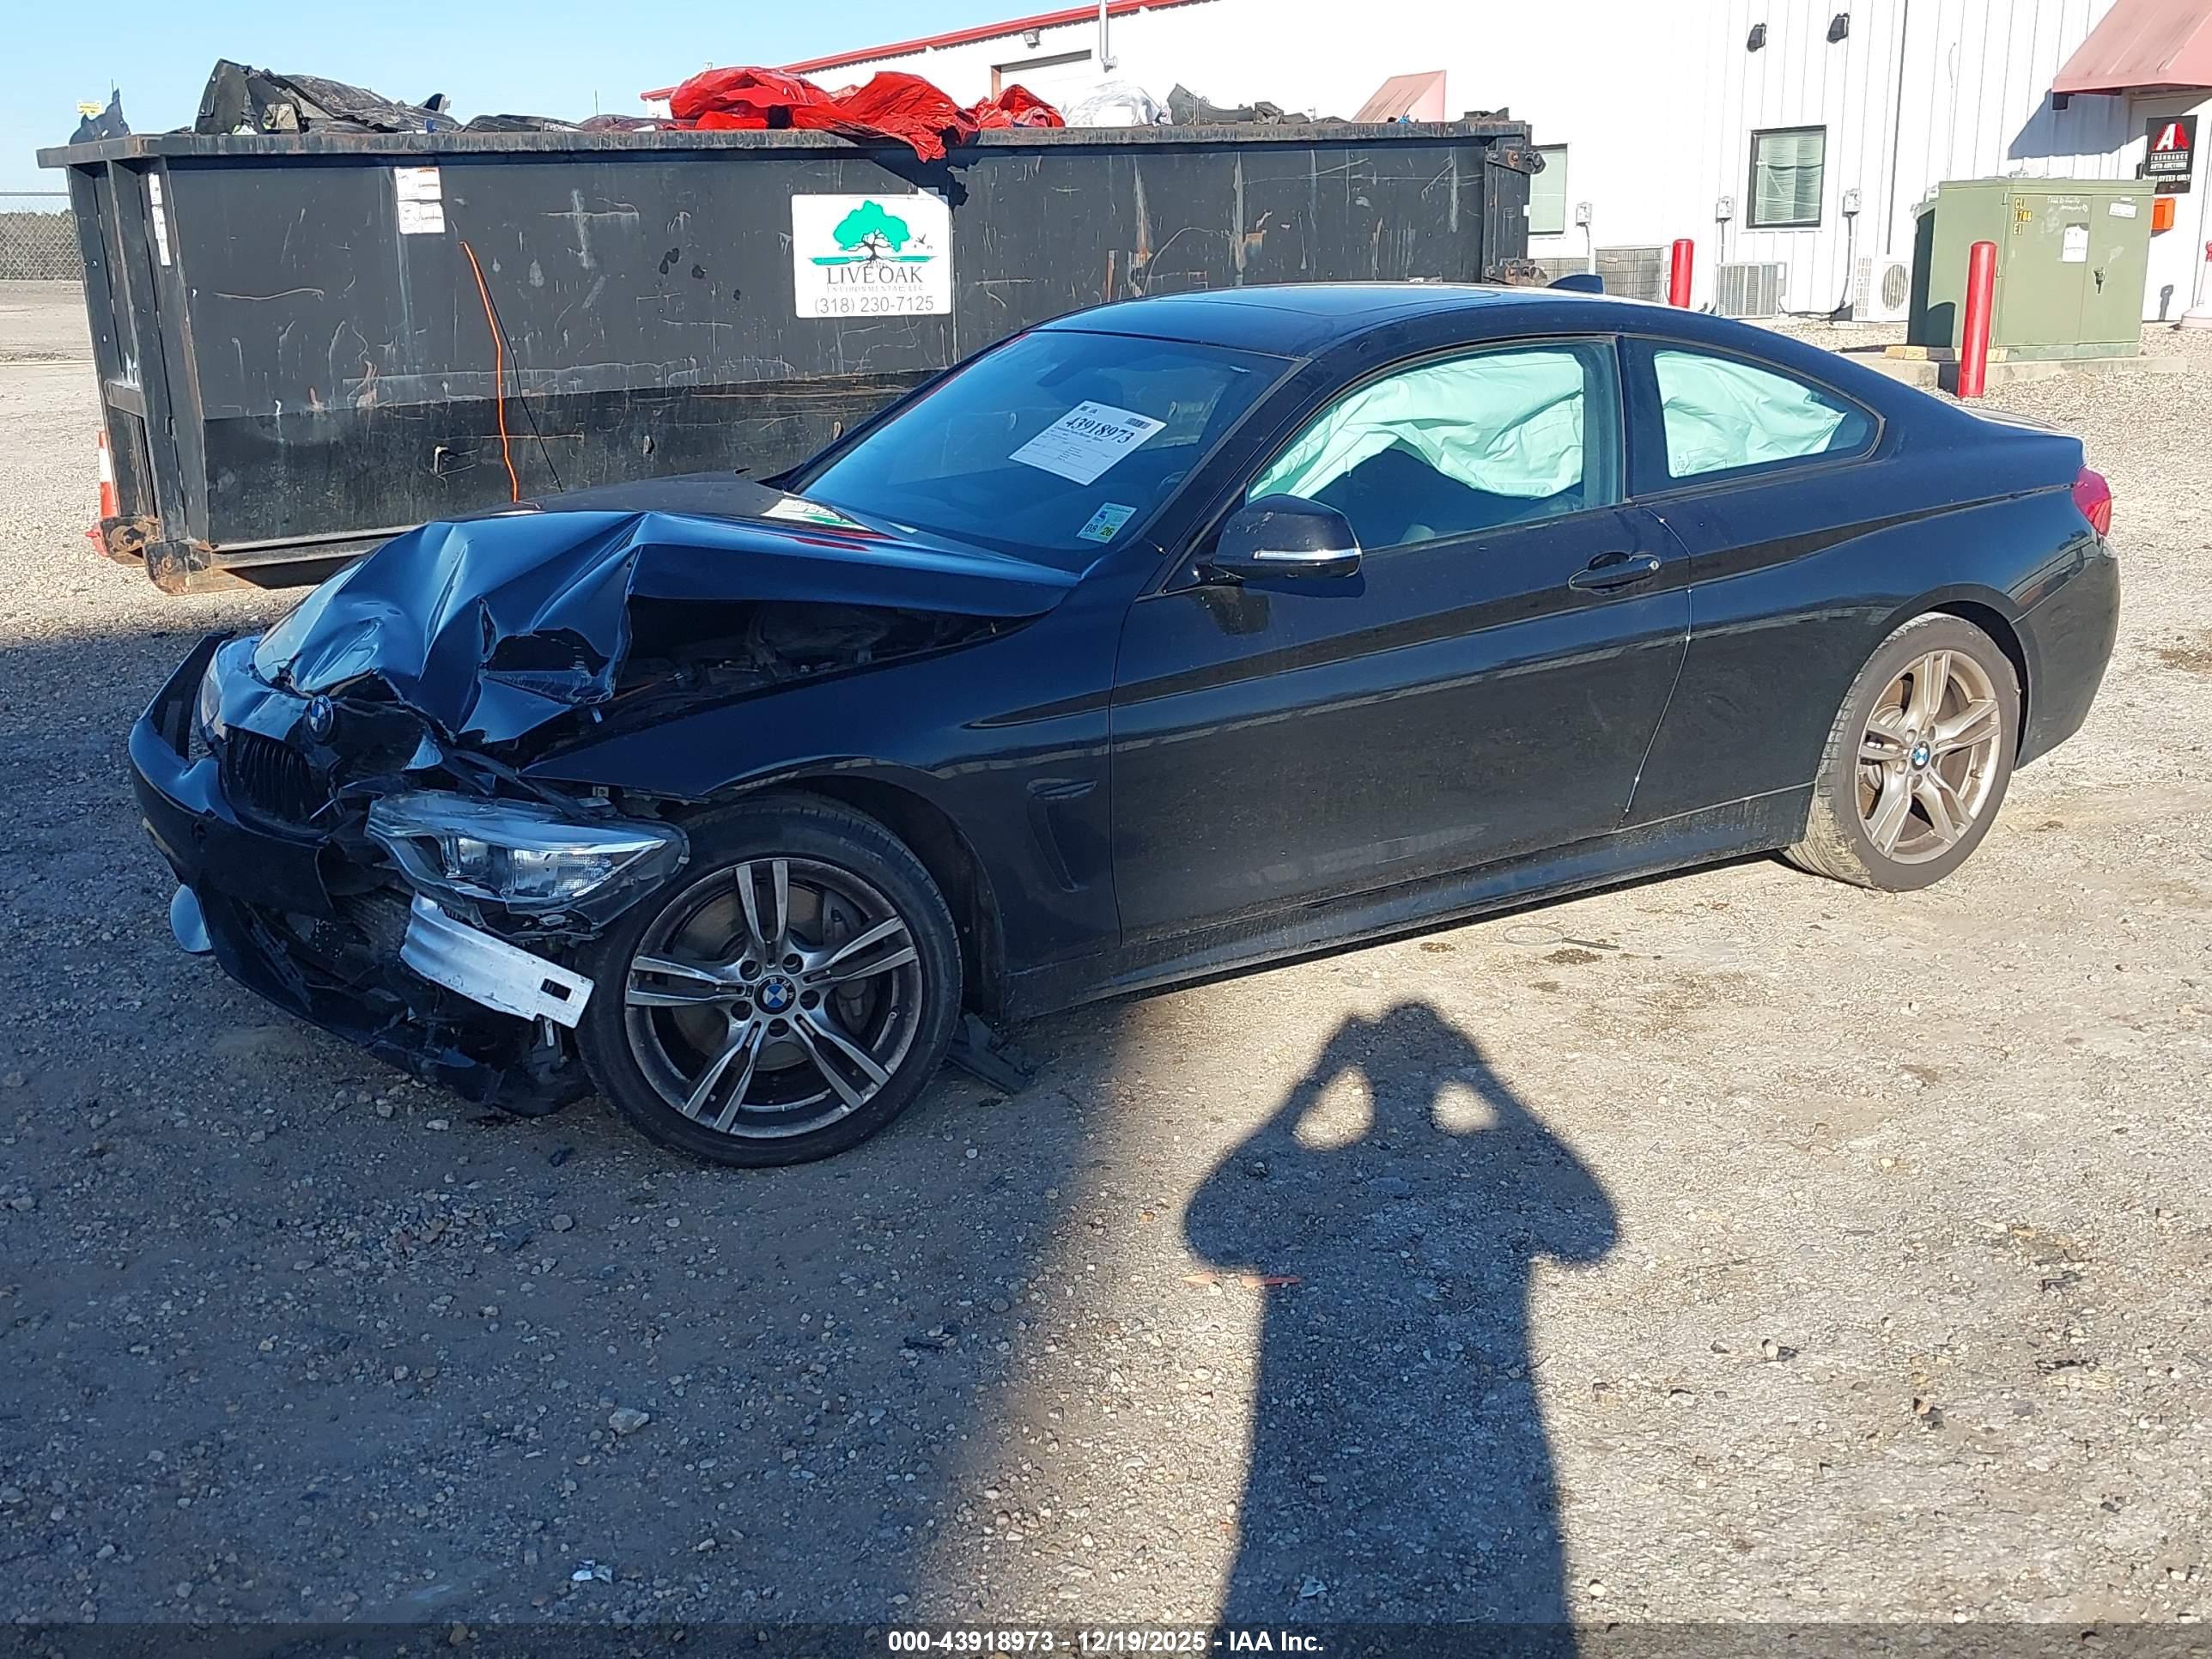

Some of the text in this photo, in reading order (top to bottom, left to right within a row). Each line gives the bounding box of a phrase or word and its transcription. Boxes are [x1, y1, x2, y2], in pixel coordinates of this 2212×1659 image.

[827, 266, 924, 284] LIVE OAK
[815, 295, 934, 314] (318) 230-7125
[1065, 416, 1135, 444] 43918973
[1085, 523, 1098, 533] 08
[1099, 526, 1115, 537] 26
